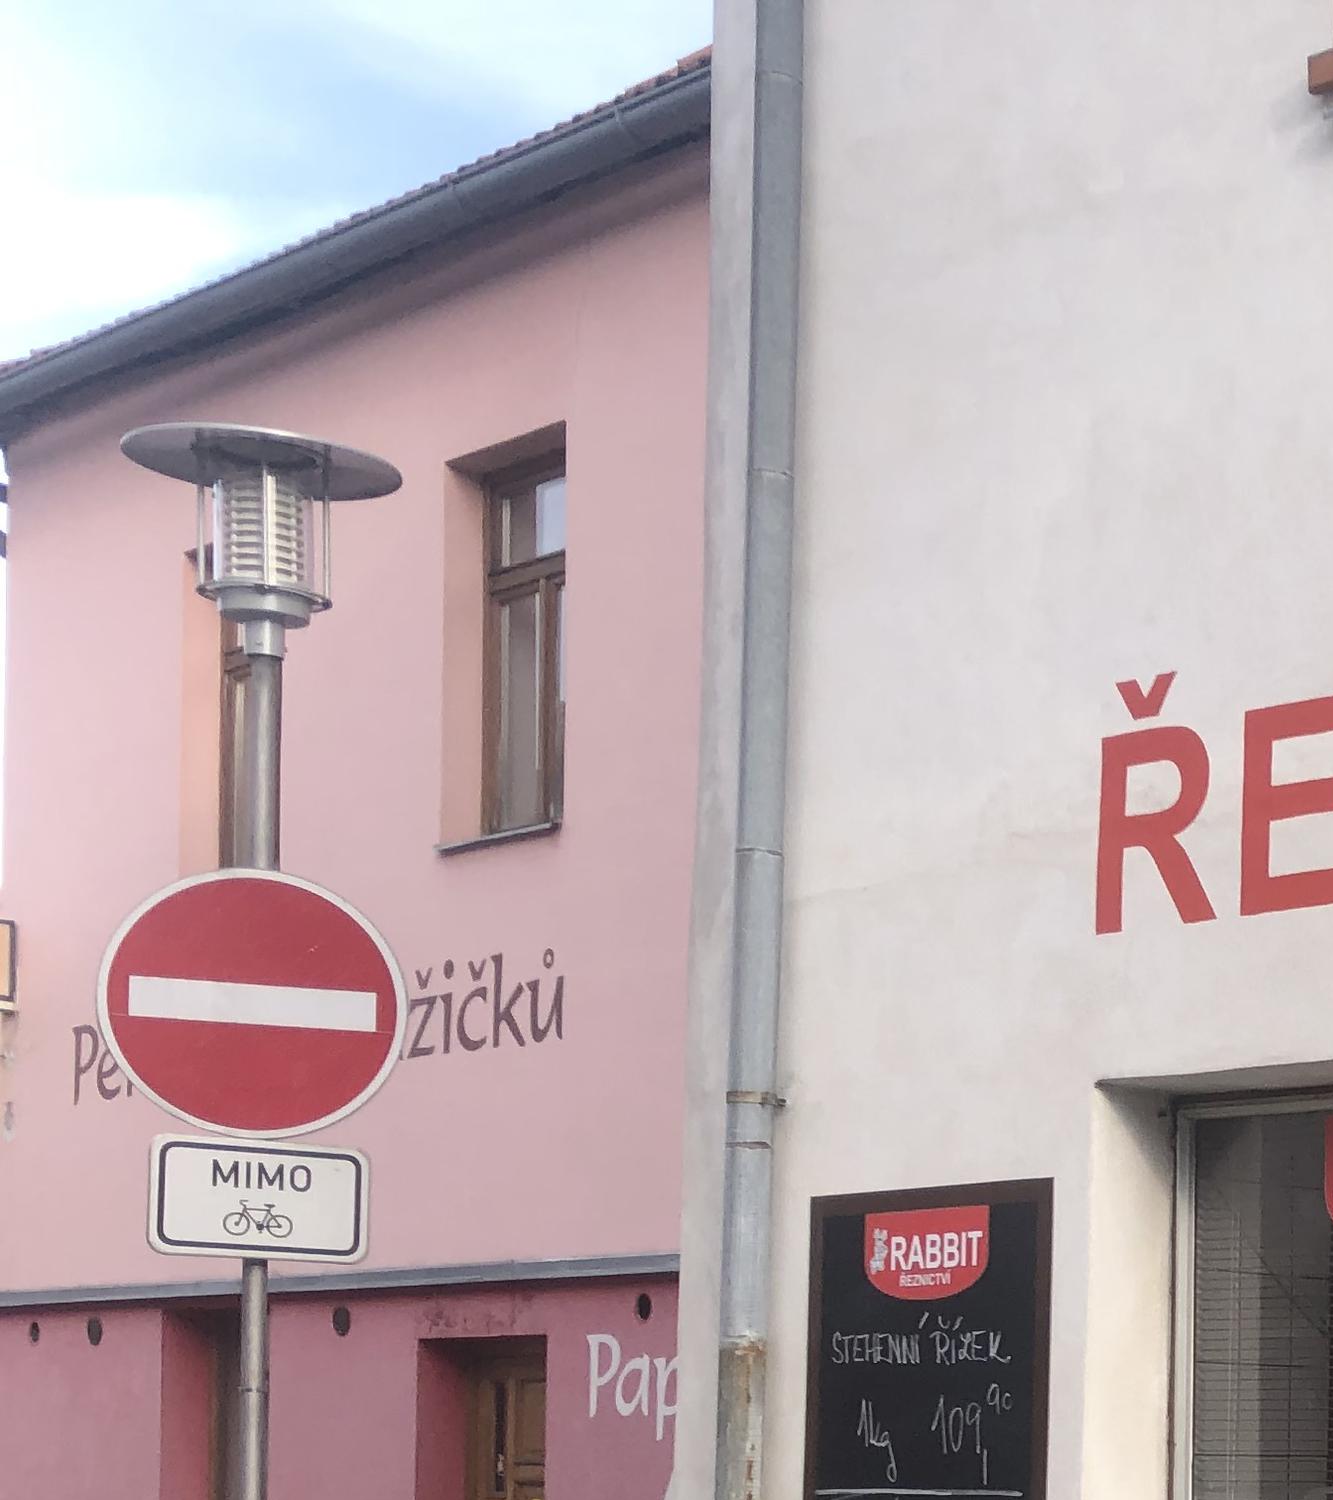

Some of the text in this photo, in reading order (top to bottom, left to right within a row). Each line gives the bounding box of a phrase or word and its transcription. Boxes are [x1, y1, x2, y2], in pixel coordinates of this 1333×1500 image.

[72, 947, 564, 1106] Pe žičků
[211, 1158, 313, 1194] MIMO
[890, 1230, 984, 1271] RABBIT
